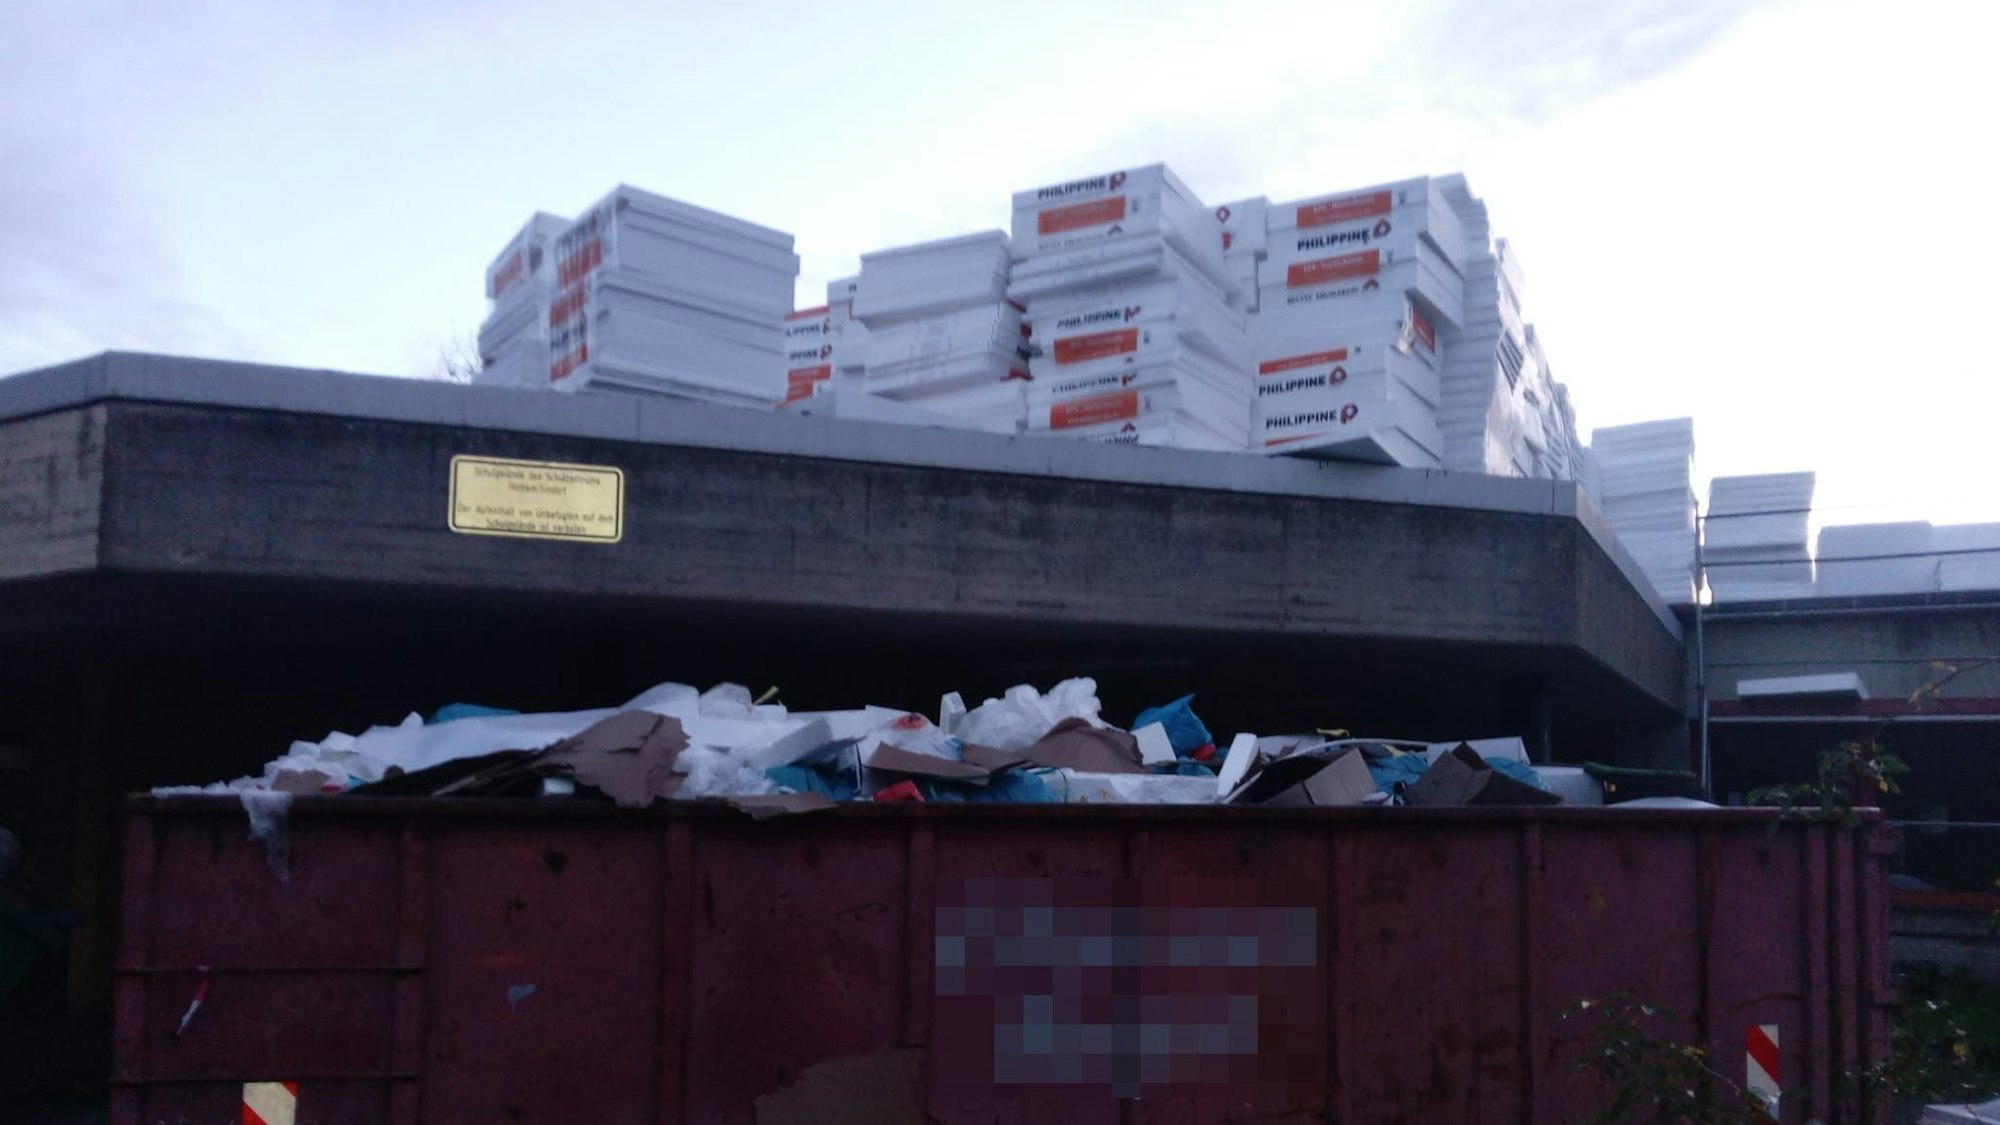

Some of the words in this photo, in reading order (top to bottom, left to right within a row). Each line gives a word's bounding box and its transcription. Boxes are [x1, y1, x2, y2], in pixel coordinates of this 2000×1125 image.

[1038, 176, 1107, 200] PHILIPPINE
[1297, 228, 1370, 252] PHILIPPINE
[1259, 375, 1327, 397] PHILIPPINE
[1266, 409, 1338, 430] PHILIPPINE
[458, 503, 472, 513] Der
[475, 505, 515, 517] Aufenthalt
[519, 509, 533, 518] von
[536, 508, 579, 521] Unbefugten
[583, 513, 595, 522] auf
[598, 513, 614, 523] dem
